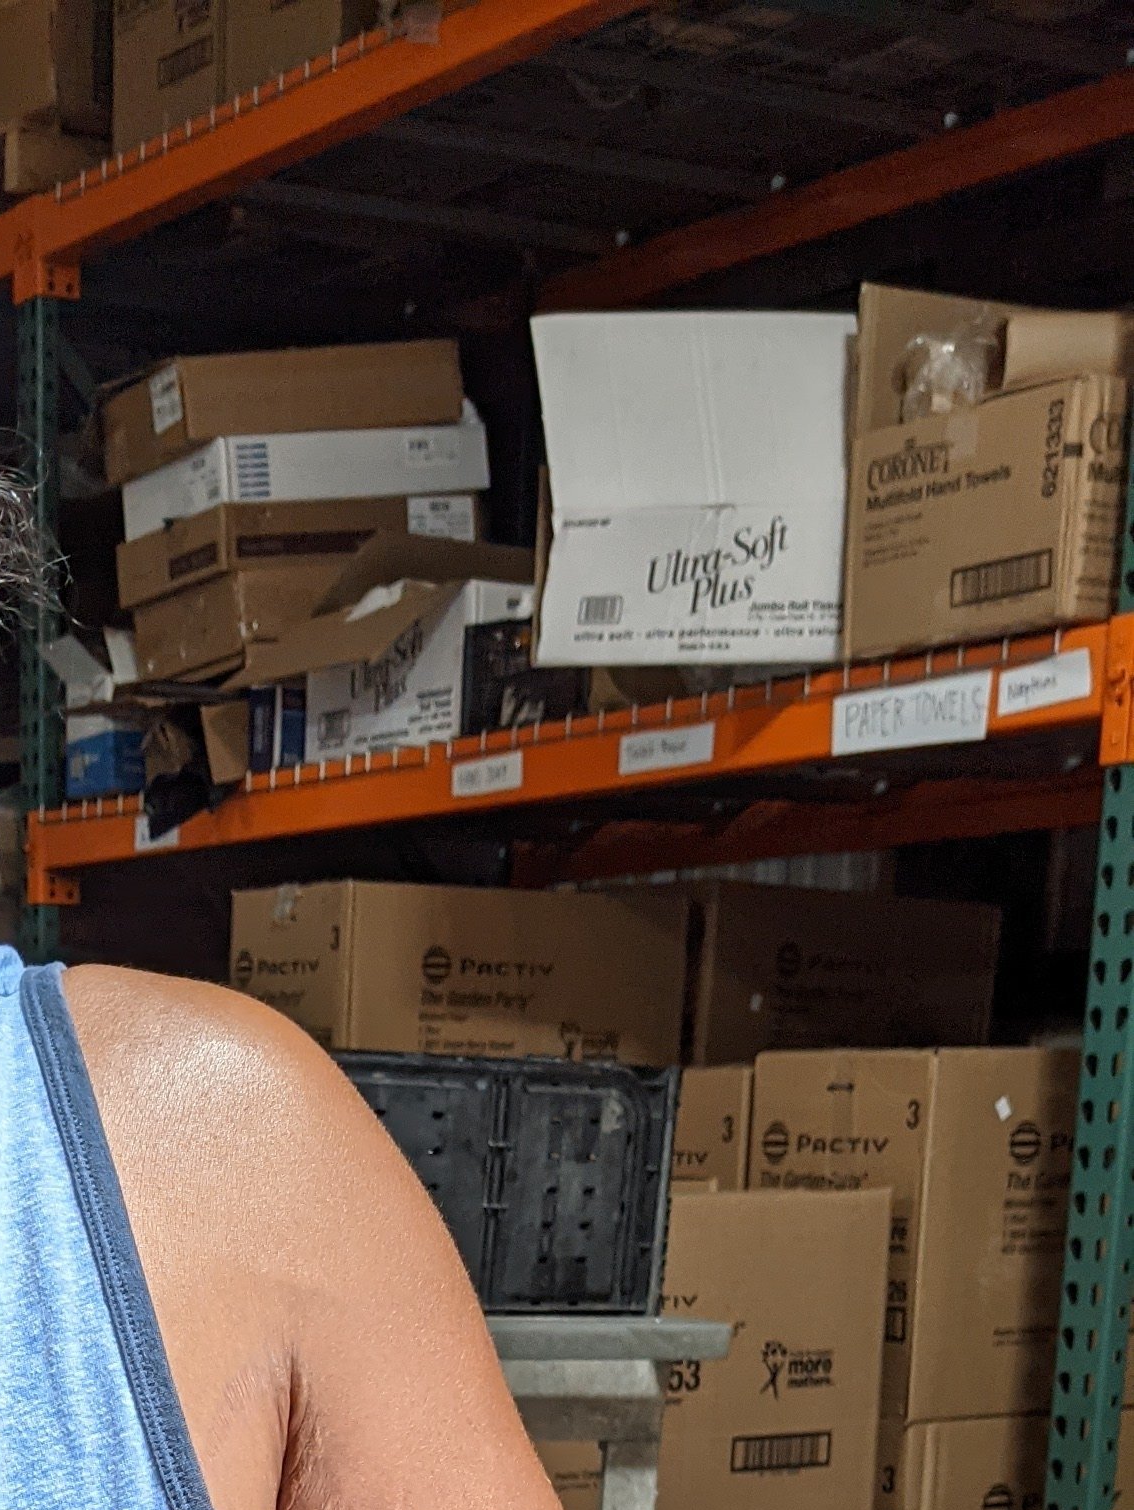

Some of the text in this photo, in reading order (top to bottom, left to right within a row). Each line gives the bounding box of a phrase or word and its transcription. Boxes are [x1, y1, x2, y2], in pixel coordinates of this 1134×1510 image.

[866, 441, 951, 492] CORONET
[925, 476, 961, 498] Hand
[965, 464, 1011, 490] Towels
[646, 515, 788, 595] Ultra-Soft
[689, 574, 755, 616] Plus
[843, 685, 985, 739] PAPER TOWELS
[257, 957, 320, 975] PACTIV
[460, 957, 555, 978] PACTIV
[905, 1099, 920, 1131] 3
[722, 1115, 734, 1144] 3
[796, 1133, 890, 1155] PACTIV
[672, 1151, 708, 1167] TIV
[659, 1294, 698, 1309] TIV
[788, 1357, 833, 1375] more
[881, 1466, 895, 1494] 3
